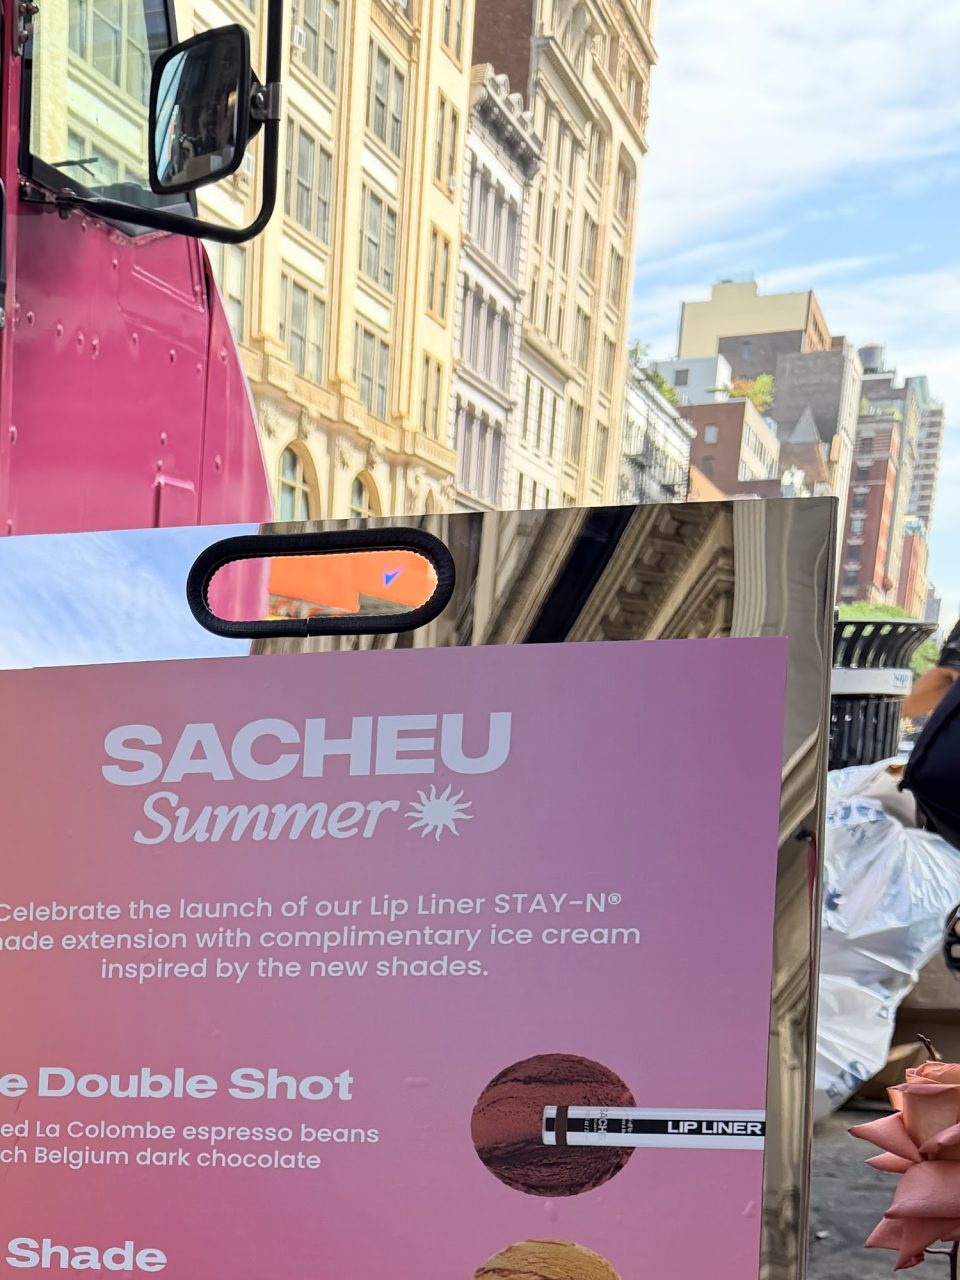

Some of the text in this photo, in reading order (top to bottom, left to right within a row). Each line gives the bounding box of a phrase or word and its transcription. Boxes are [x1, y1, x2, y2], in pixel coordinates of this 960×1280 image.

[101, 711, 512, 786] SACHEU
[133, 791, 401, 845] Summer
[128, 899, 172, 920] the
[179, 896, 273, 919] launch
[280, 895, 308, 917] of
[315, 899, 363, 917] our
[370, 894, 409, 922] Lip
[417, 893, 486, 915] Liner
[61, 928, 187, 950] extension
[195, 927, 251, 948] with
[259, 925, 482, 954] complimentary
[490, 923, 533, 945] ice
[541, 927, 641, 945] cream
[101, 955, 489, 985] inspired by the new shades.
[38, 1066, 218, 1099] Double
[227, 1067, 354, 1101] Shot
[35, 1120, 61, 1138] La
[66, 1120, 176, 1140] Colombe
[182, 1125, 293, 1146] espresso
[300, 1123, 380, 1144] beans
[667, 1120, 762, 1135] LIP LINER
[34, 1145, 129, 1170] Belgium
[135, 1147, 191, 1167] dark
[196, 1148, 321, 1170] chocolate
[5, 1237, 168, 1273] Shade
